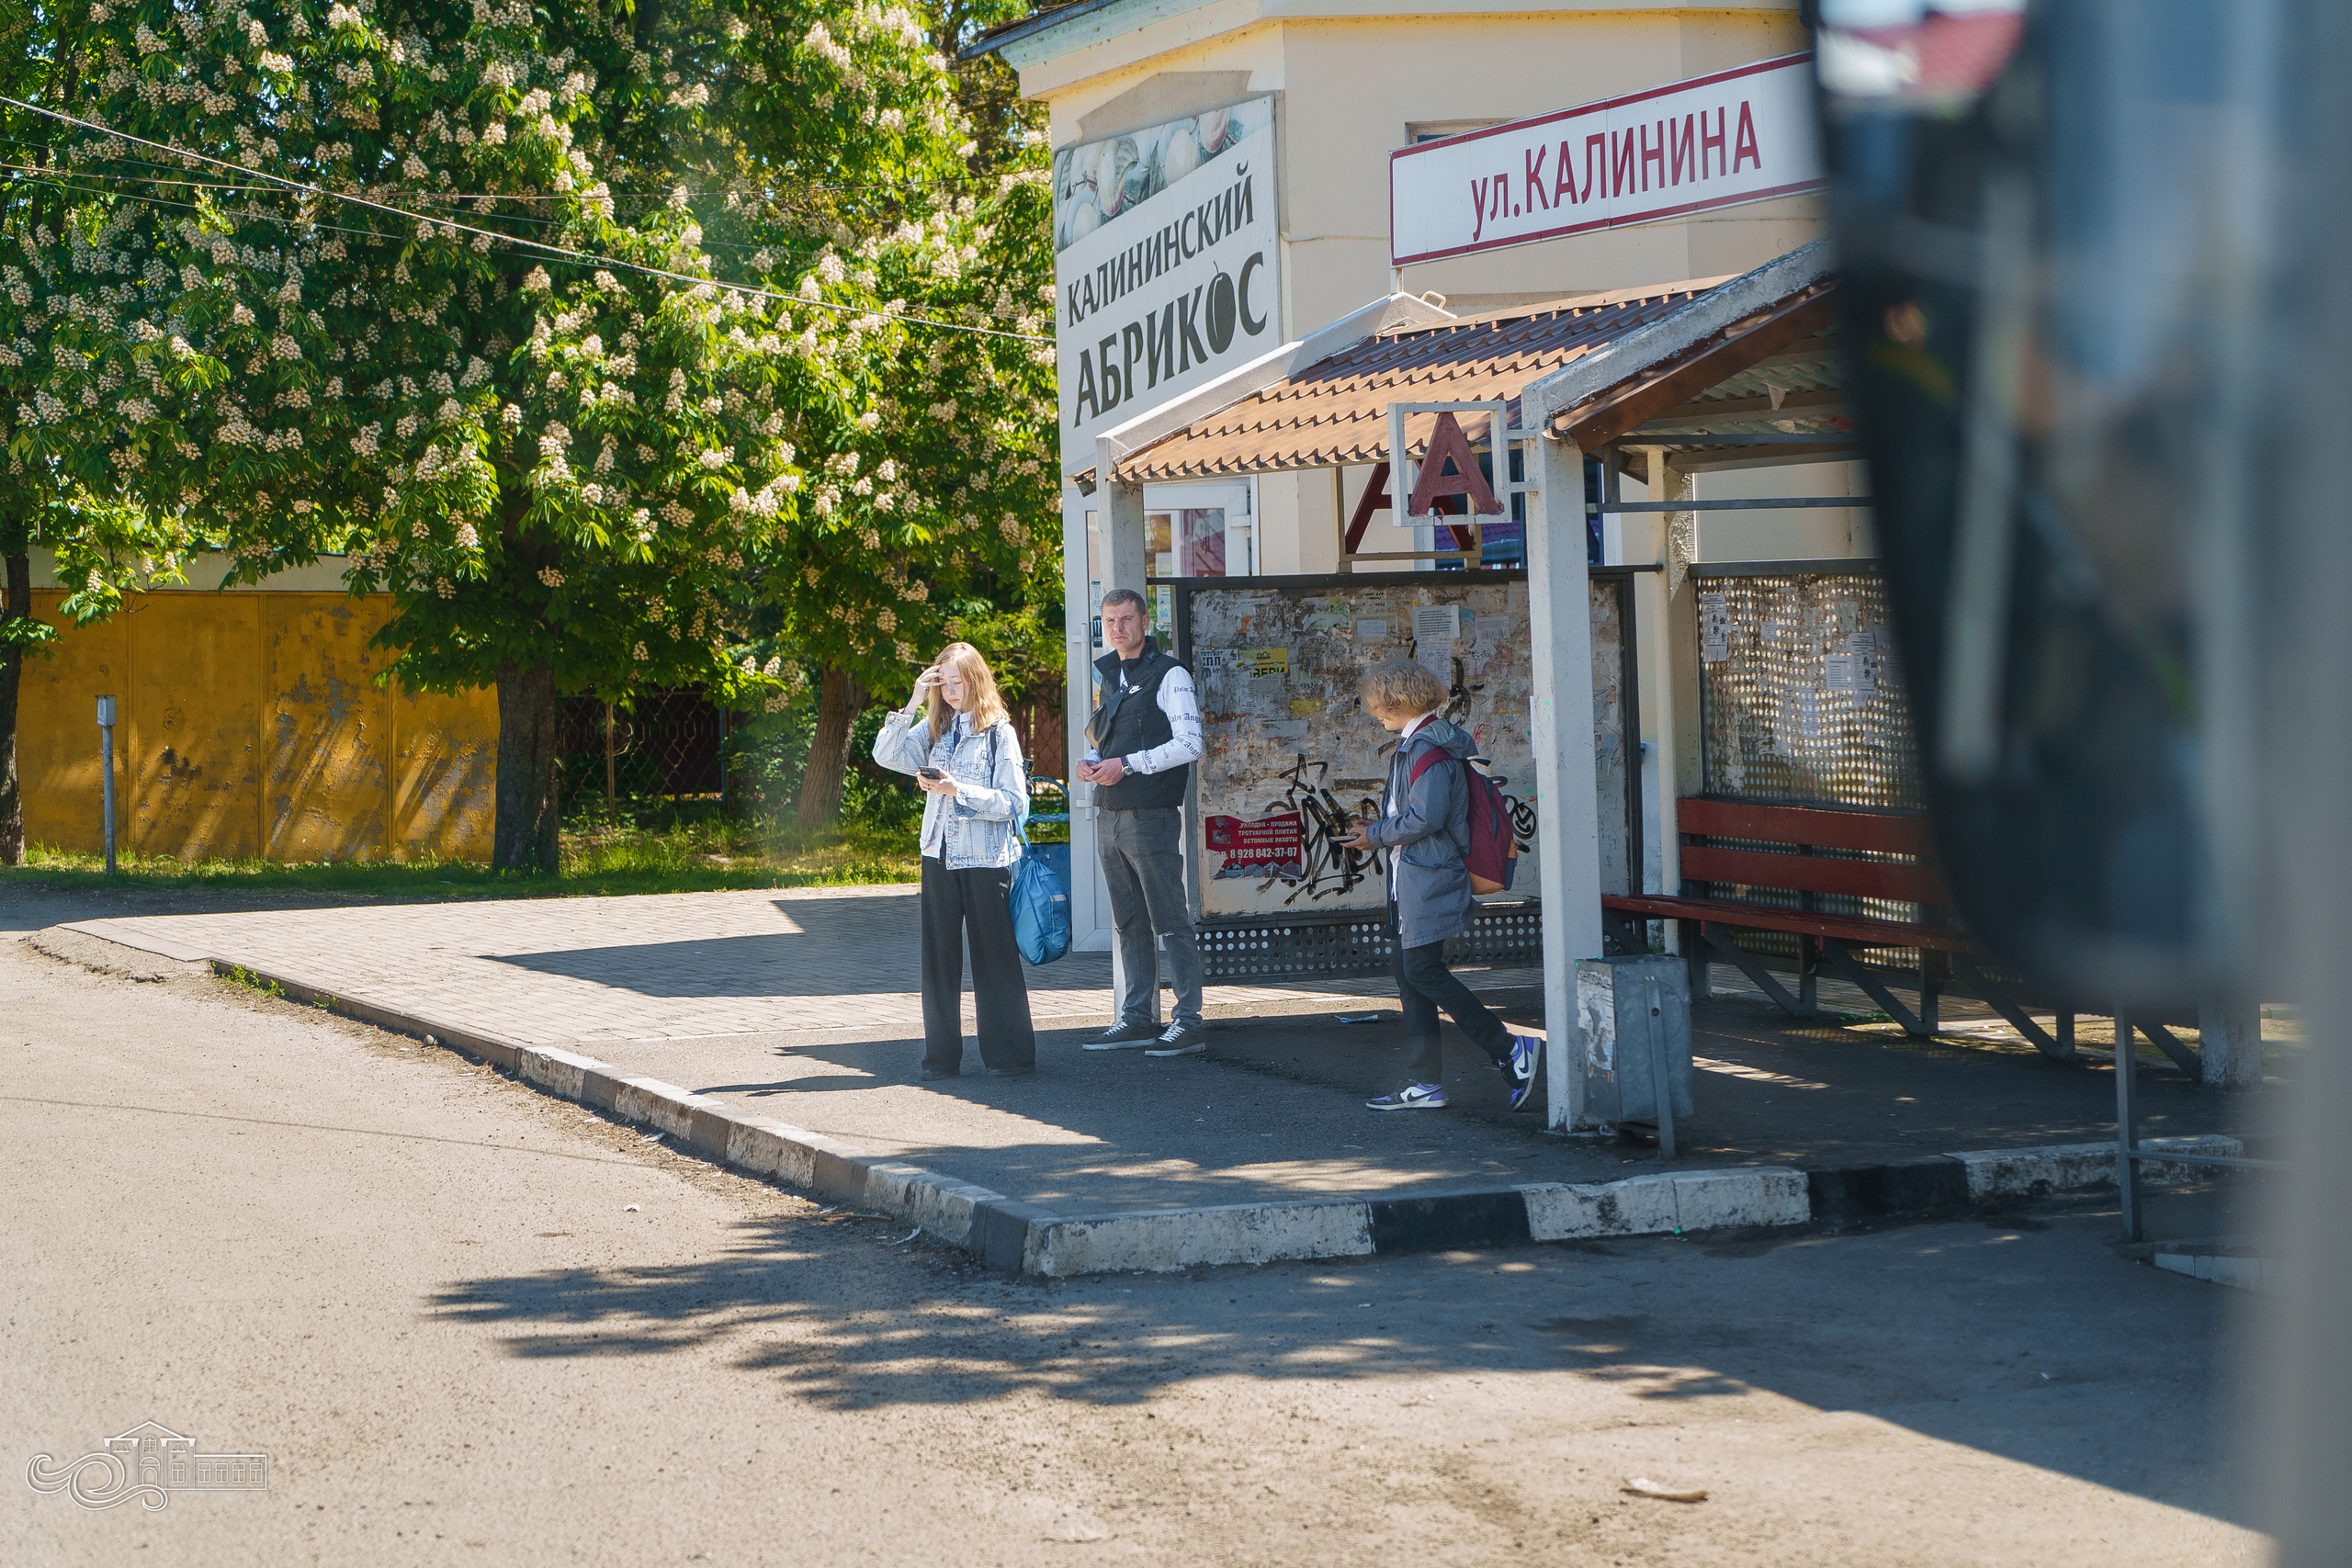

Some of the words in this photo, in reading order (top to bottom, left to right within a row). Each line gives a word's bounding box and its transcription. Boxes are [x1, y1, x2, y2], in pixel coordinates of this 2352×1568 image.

[1471, 100, 1761, 243] ул.КАЛИНИНА
[1067, 160, 1254, 328] КАЛИНИНСКИЙ
[1074, 252, 1268, 428] АБРИКОС
[1250, 667, 1285, 678] ВЕРИ
[1230, 849, 1236, 859] 8
[1238, 849, 1254, 859] 928
[1256, 847, 1297, 858] 842-37-07
